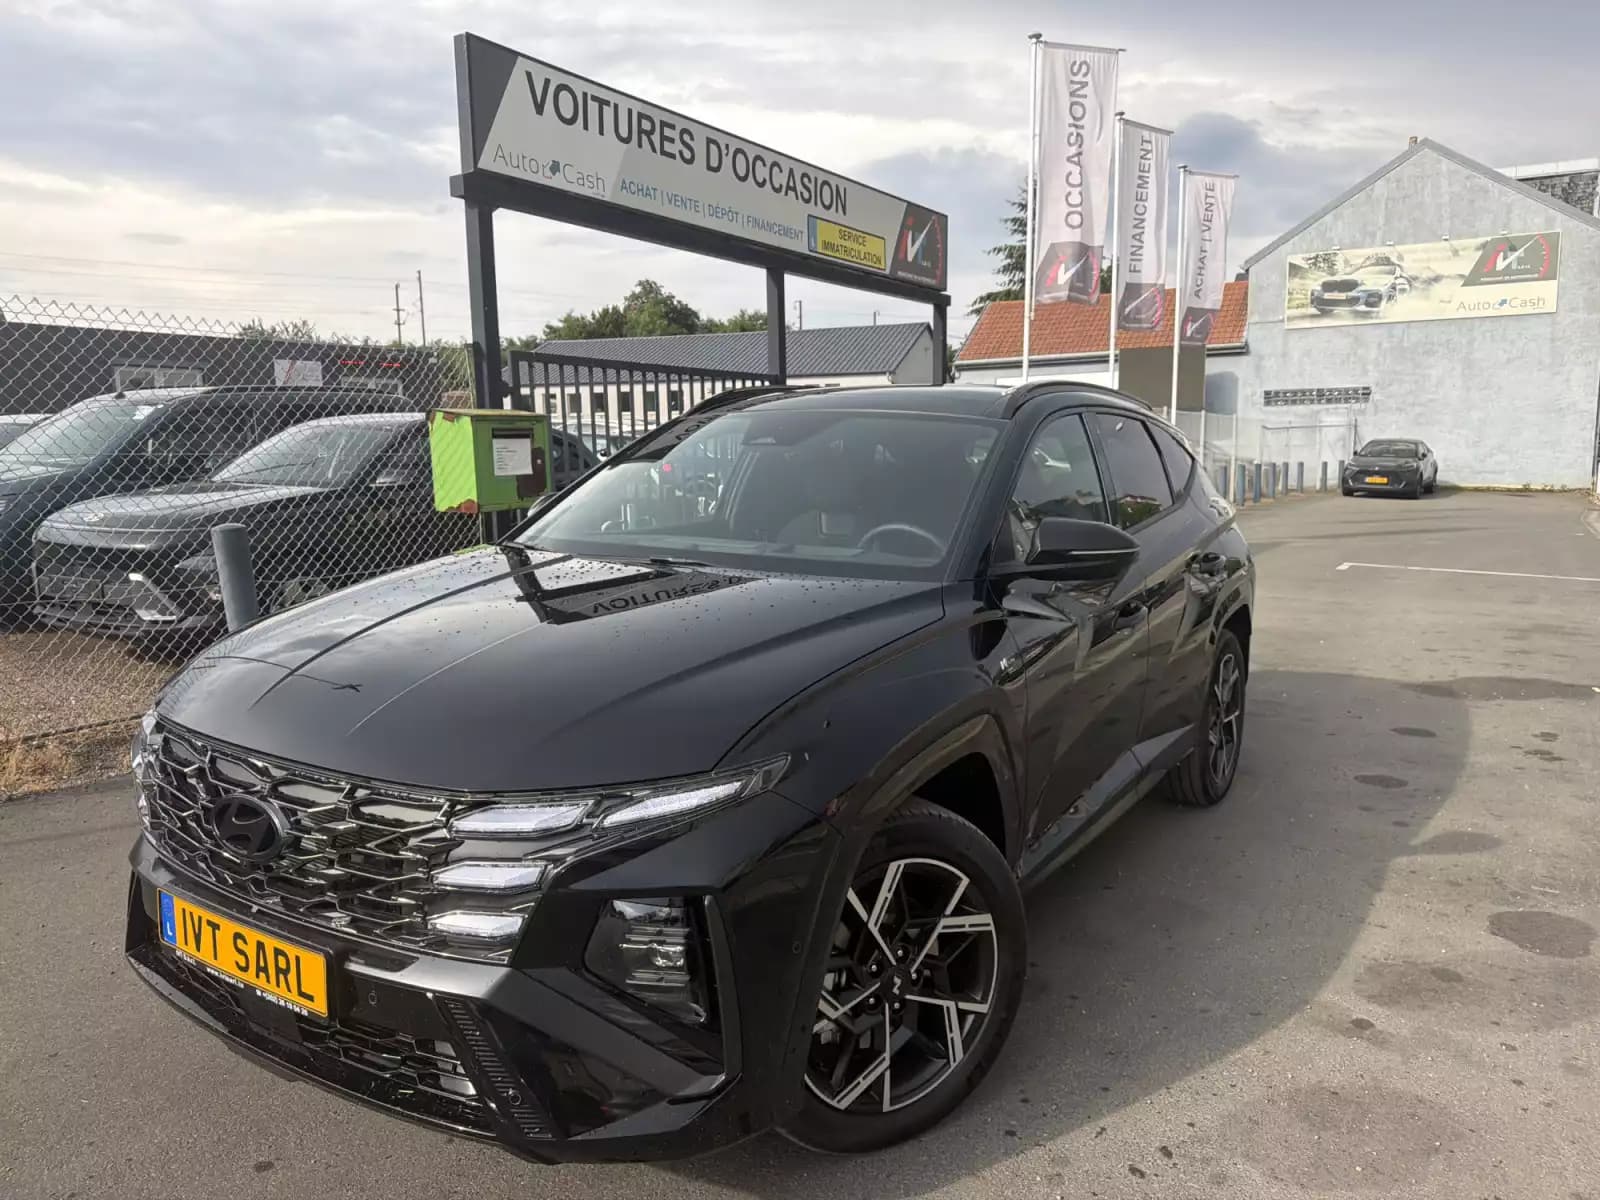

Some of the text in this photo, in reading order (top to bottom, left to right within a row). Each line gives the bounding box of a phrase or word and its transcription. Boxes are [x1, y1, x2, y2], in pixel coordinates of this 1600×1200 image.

[523, 69, 848, 217] VOITURES D'OCCASION
[562, 162, 606, 193] Cash
[1064, 58, 1091, 231] OCCASIONS
[620, 177, 658, 201] ACHAT
[666, 193, 701, 214] VENTE
[747, 214, 805, 242] FINANCEMENT
[821, 239, 883, 266] IMMATRICULATION
[838, 228, 867, 247] SERVICE
[1128, 135, 1154, 274] FINANCEMENT
[1192, 180, 1216, 299] ACHAT VENTE
[181, 907, 221, 961] IVT
[232, 931, 315, 1003] SARL
